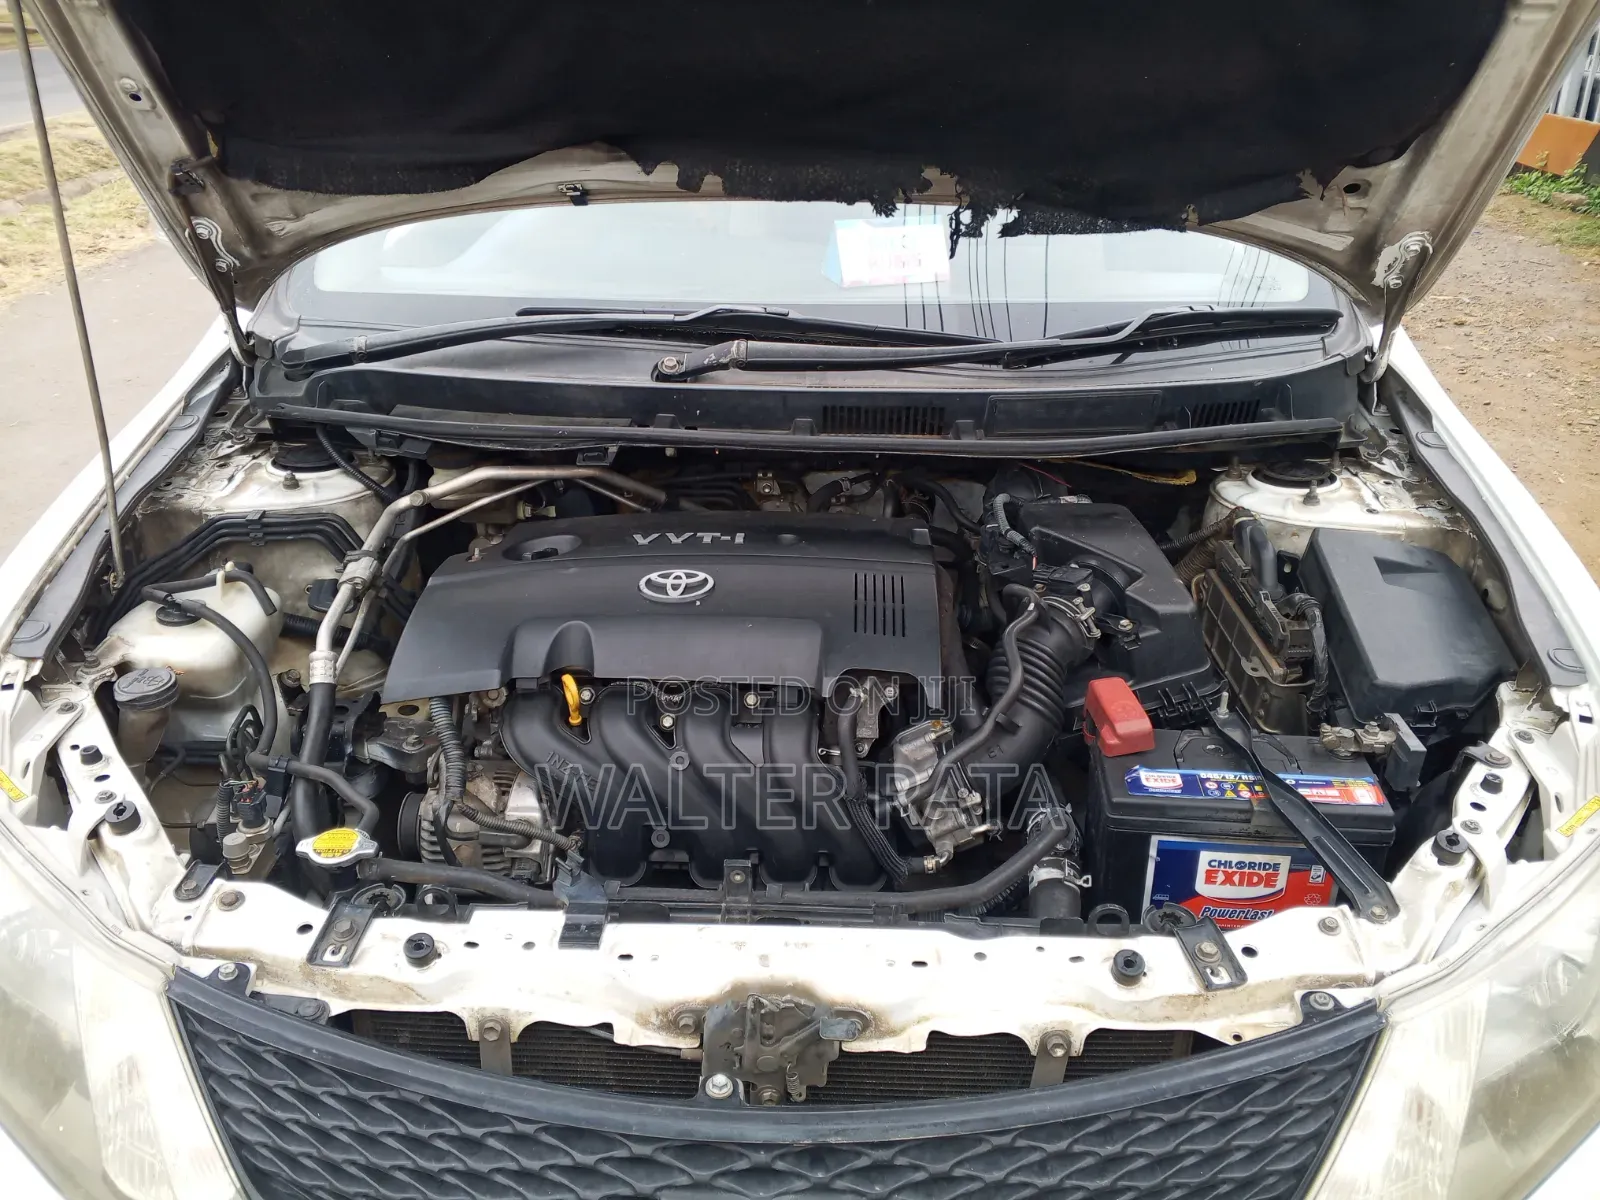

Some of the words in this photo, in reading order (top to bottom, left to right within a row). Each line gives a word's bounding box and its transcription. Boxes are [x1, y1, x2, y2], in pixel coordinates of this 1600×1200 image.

[632, 532, 745, 545] VVT-I
[1207, 859, 1282, 872] CHLORIDE
[1204, 869, 1281, 888] EXIDE
